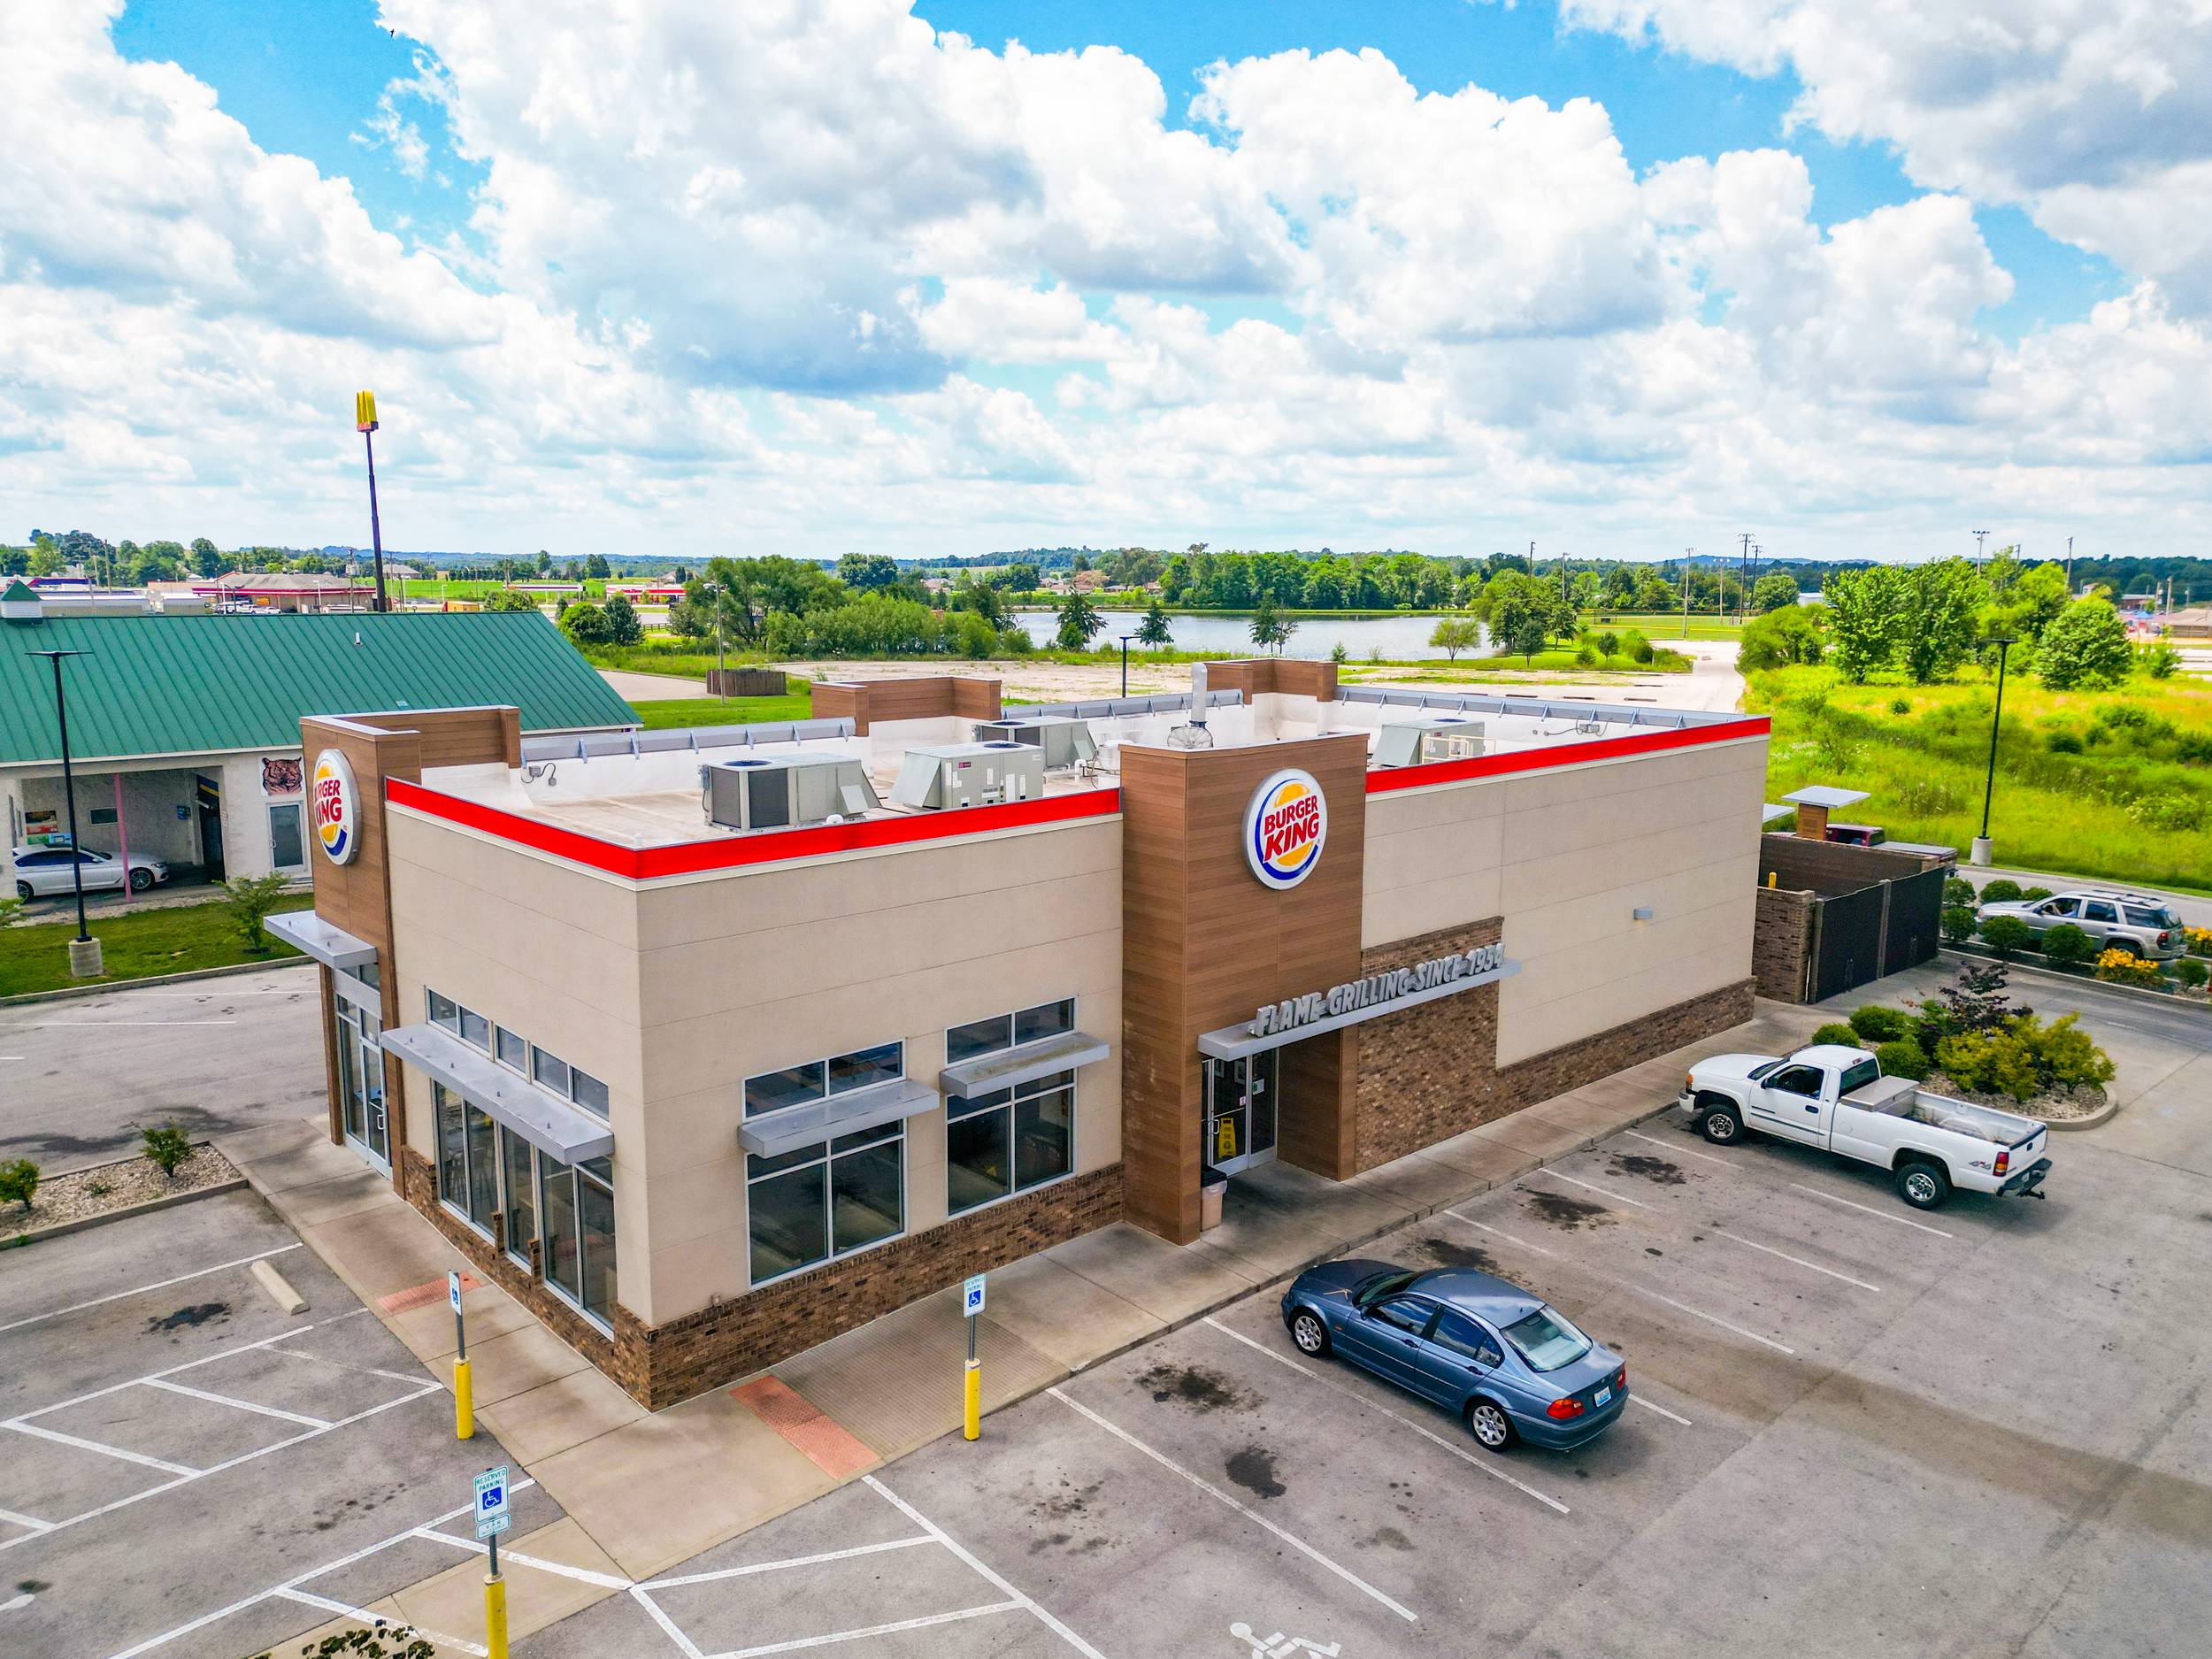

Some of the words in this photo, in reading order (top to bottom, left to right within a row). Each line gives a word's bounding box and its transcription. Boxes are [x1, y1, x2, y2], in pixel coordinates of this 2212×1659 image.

[1263, 795, 1318, 836] BURGER
[1263, 812, 1319, 862] KING
[1254, 991, 1323, 1038] FLAME
[1327, 967, 1411, 1017] GRILLING
[1416, 954, 1462, 992] SINCE
[476, 1469, 506, 1485] RESERVED
[479, 1478, 504, 1493] PARKING
